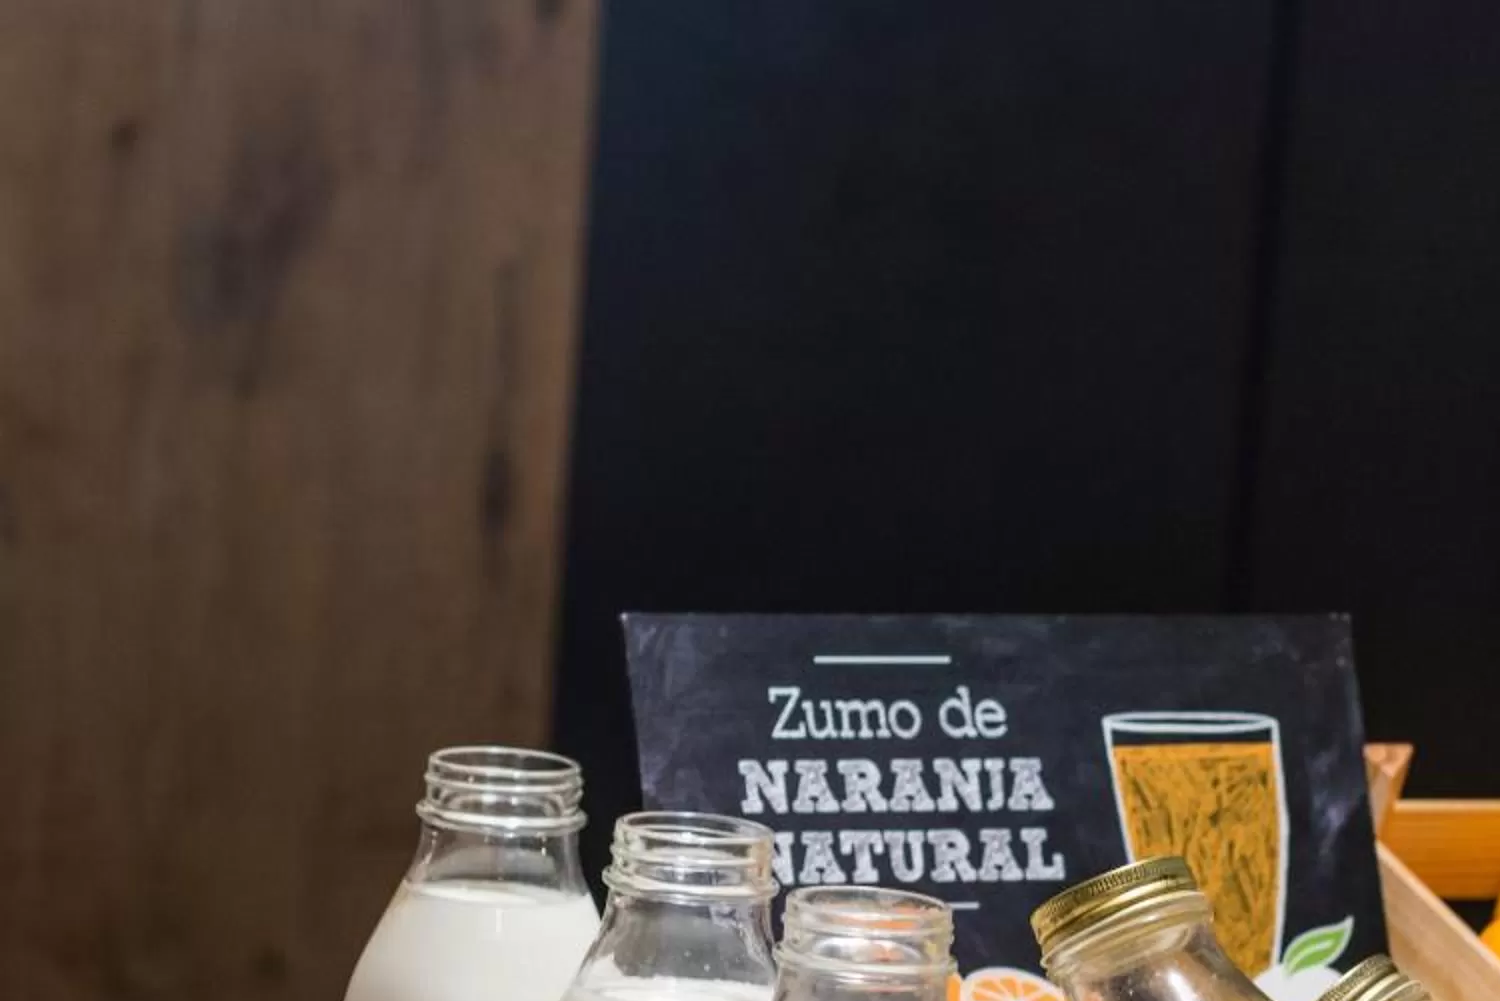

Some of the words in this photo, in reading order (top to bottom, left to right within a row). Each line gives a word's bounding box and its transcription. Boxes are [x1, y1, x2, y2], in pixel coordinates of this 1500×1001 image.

[768, 686, 922, 739] Zumo
[938, 685, 1008, 739] de
[737, 757, 1054, 814] NARANJA
